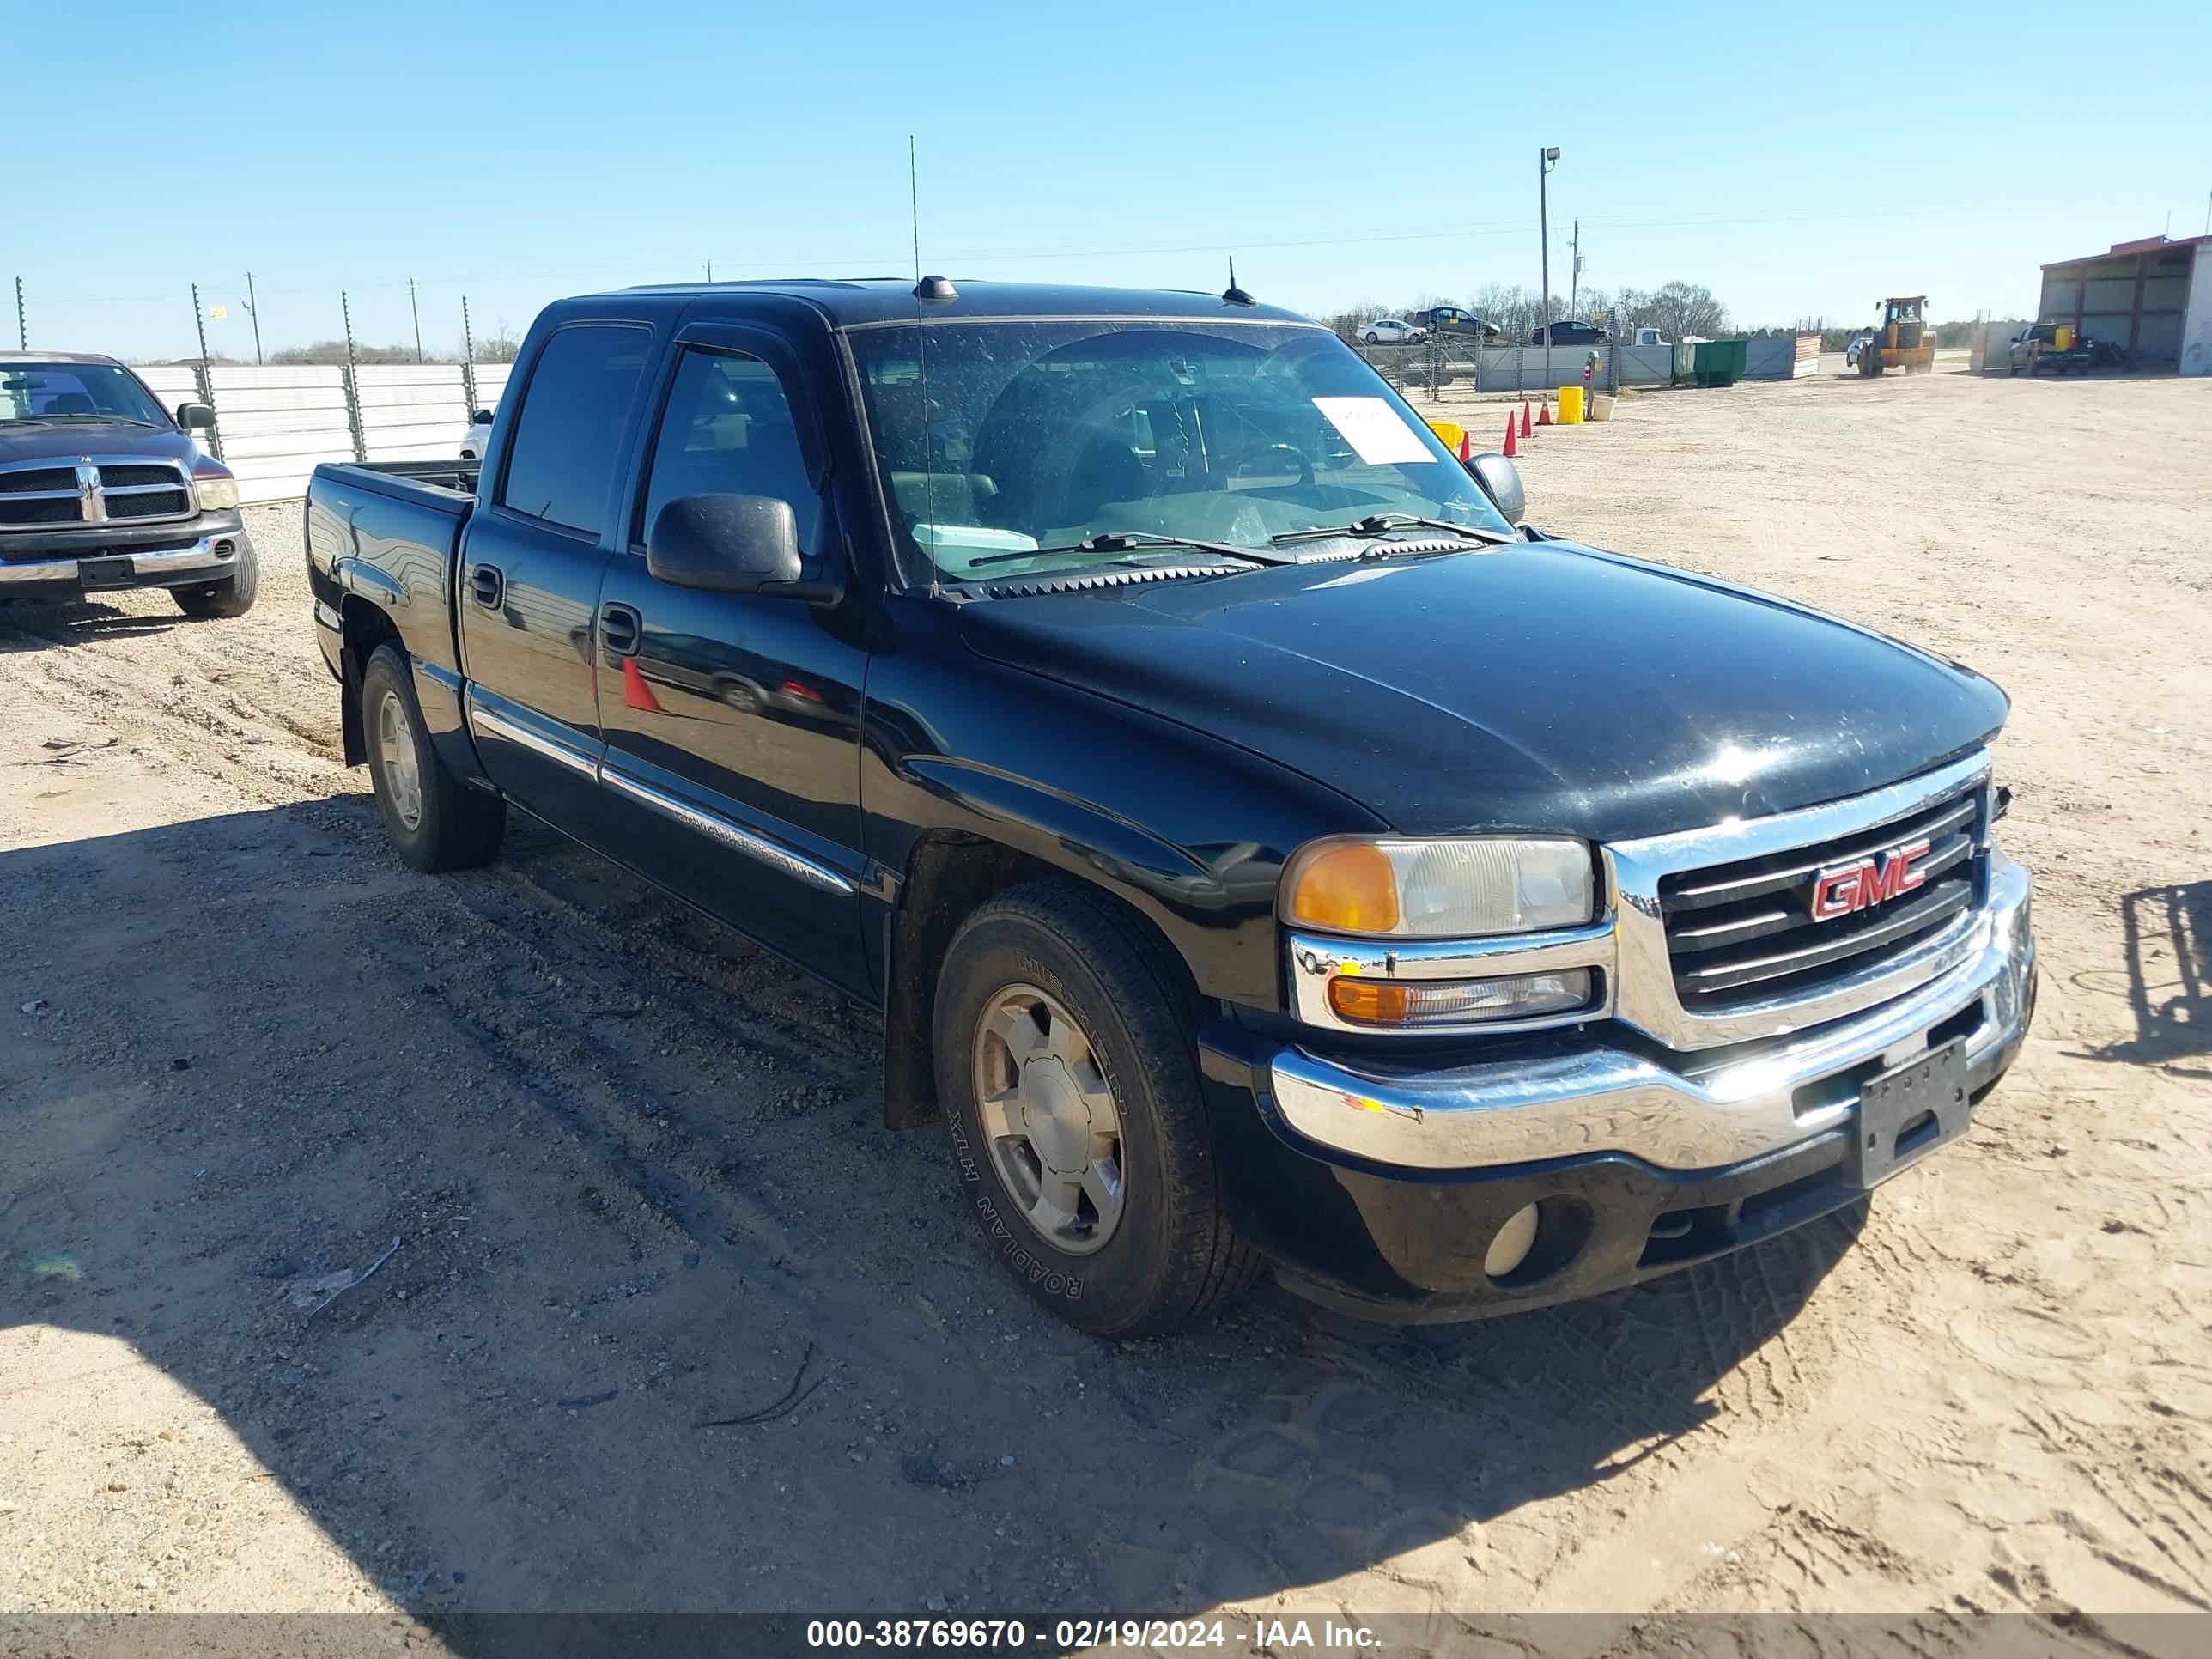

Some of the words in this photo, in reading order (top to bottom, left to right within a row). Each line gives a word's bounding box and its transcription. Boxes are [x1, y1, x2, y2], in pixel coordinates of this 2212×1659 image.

[1811, 838, 1930, 922] GMC
[1015, 950, 1128, 1115] NEXEN
[947, 1108, 981, 1182] HTX
[977, 1195, 1085, 1299] ROADIAN
